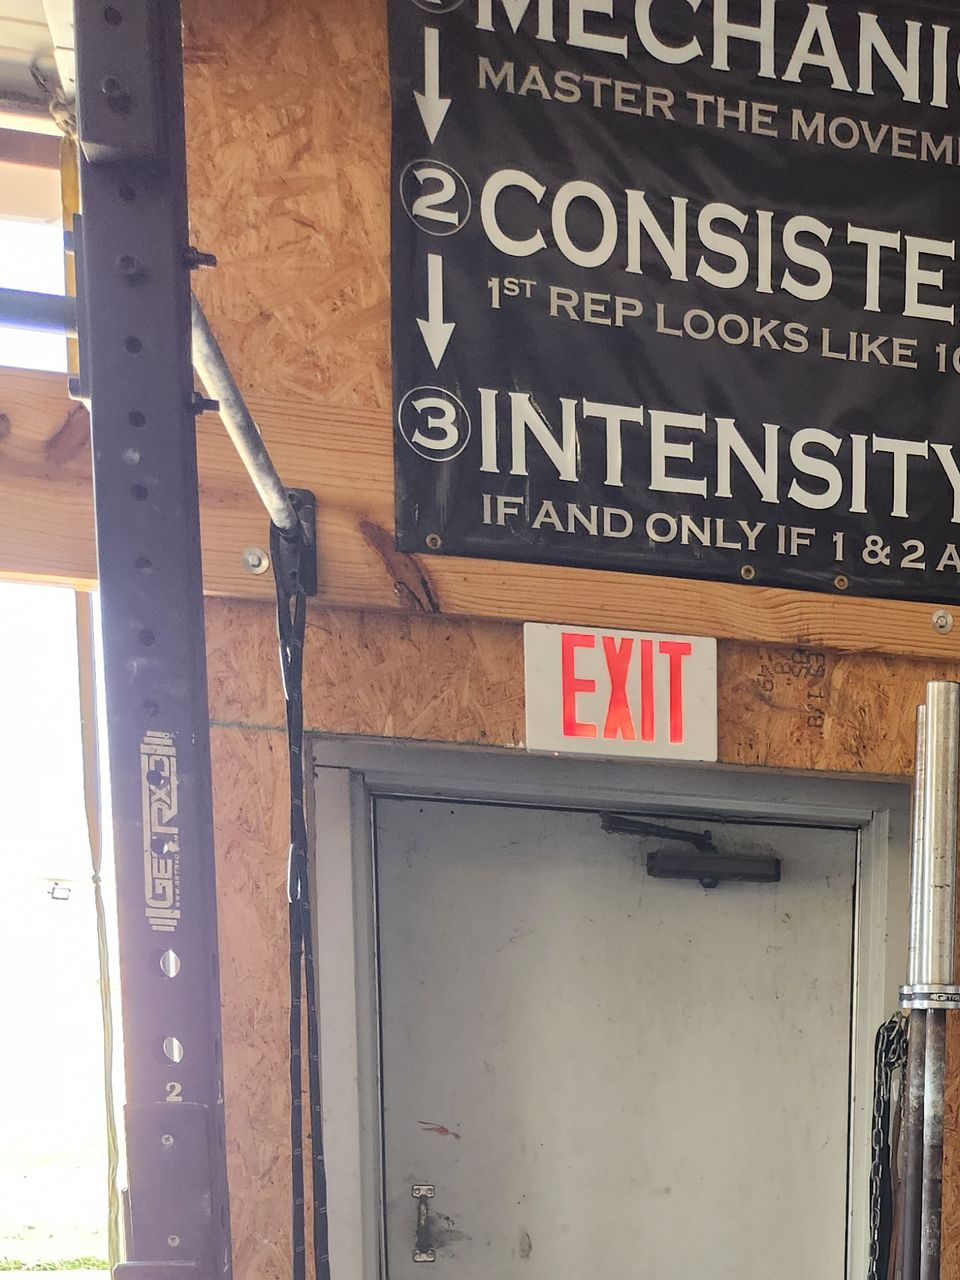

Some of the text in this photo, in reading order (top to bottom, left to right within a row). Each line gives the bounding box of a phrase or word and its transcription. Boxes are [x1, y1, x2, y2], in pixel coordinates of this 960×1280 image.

[477, 56, 676, 121] MASTER
[686, 90, 778, 138] THE
[409, 164, 463, 230] 2
[488, 277, 537, 309] 1ST
[549, 285, 644, 328] REP
[656, 302, 810, 354] LOOKS
[821, 327, 918, 370] LIKE
[408, 394, 464, 454] 3
[482, 493, 525, 527] IF
[531, 500, 634, 538] AND
[645, 512, 767, 552] ONLY
[777, 525, 816, 556] IF
[832, 531, 845, 561] 1
[862, 535, 891, 566] &
[900, 539, 926, 571] 2
[561, 632, 693, 745] EXIT
[165, 1082, 183, 1102] 2
